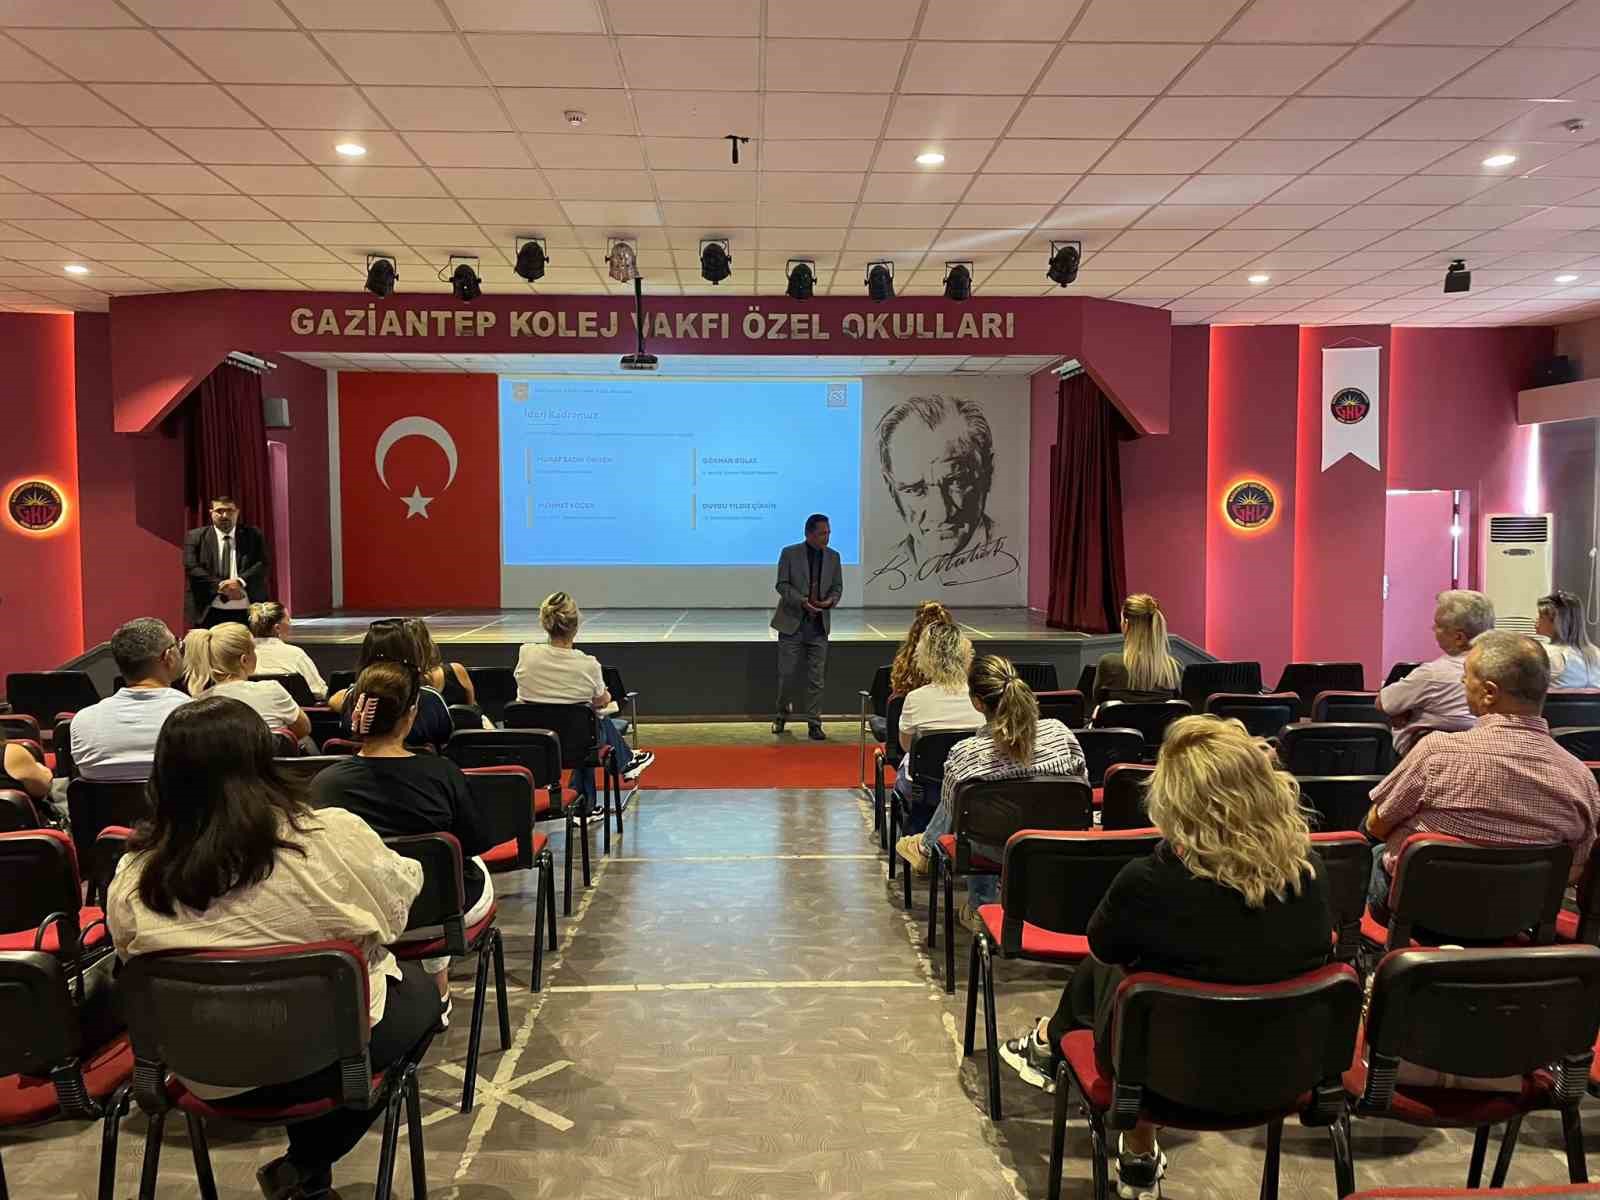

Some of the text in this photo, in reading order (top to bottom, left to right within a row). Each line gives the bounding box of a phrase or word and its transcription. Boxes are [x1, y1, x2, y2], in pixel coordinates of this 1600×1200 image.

[290, 303, 496, 337] GAZİANTEP
[509, 311, 619, 338] KOLEJ
[742, 306, 830, 340] ÖZEL
[842, 312, 1015, 340] OKULLARI
